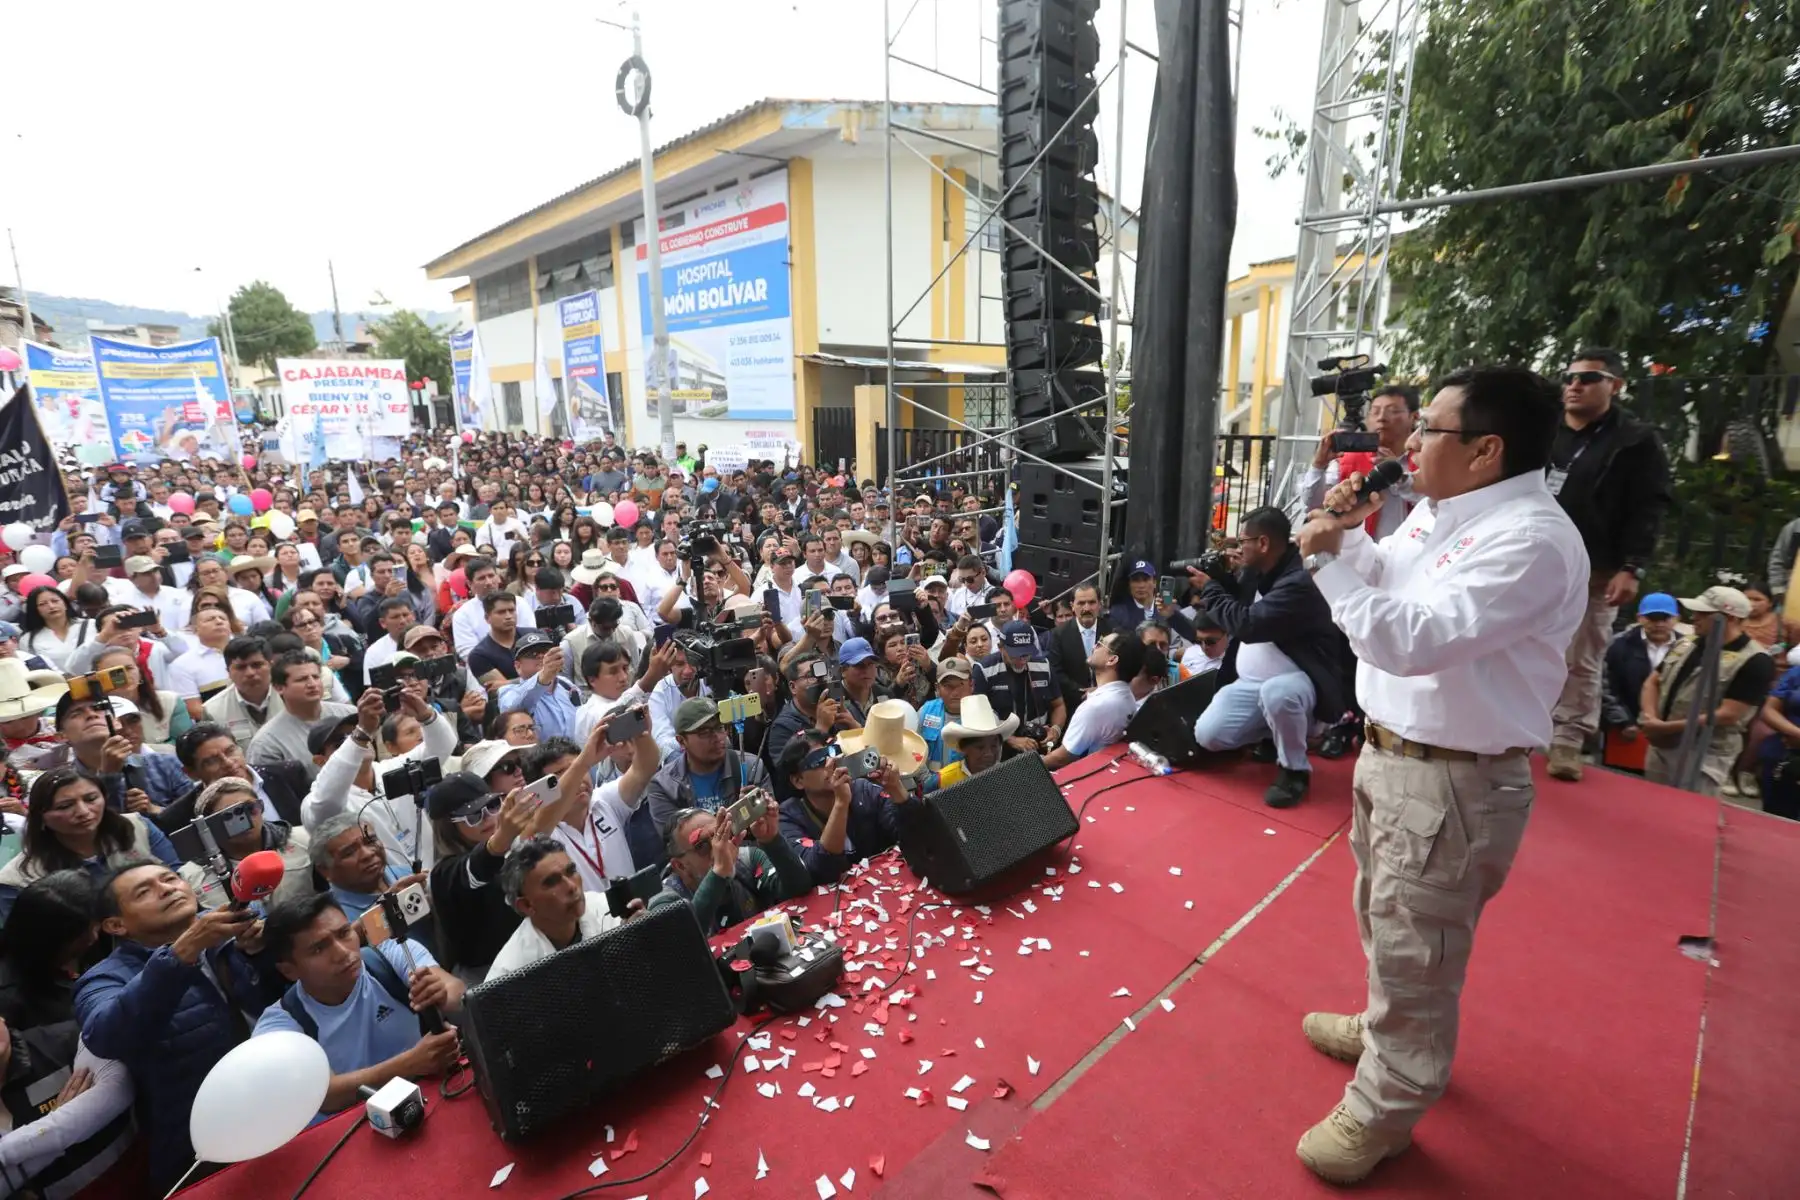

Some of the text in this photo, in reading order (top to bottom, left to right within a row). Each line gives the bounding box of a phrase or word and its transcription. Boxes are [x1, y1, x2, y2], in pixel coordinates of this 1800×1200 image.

[704, 217, 749, 240] CONSTRUYE
[677, 259, 733, 286] HOSPITAL
[664, 277, 768, 317] MÓN BOLÍVAR
[284, 366, 408, 381] CAJABAMBA
[314, 379, 379, 388] PRESENE
[308, 392, 392, 402] BIENVENO
[1013, 636, 1031, 644] Salud
